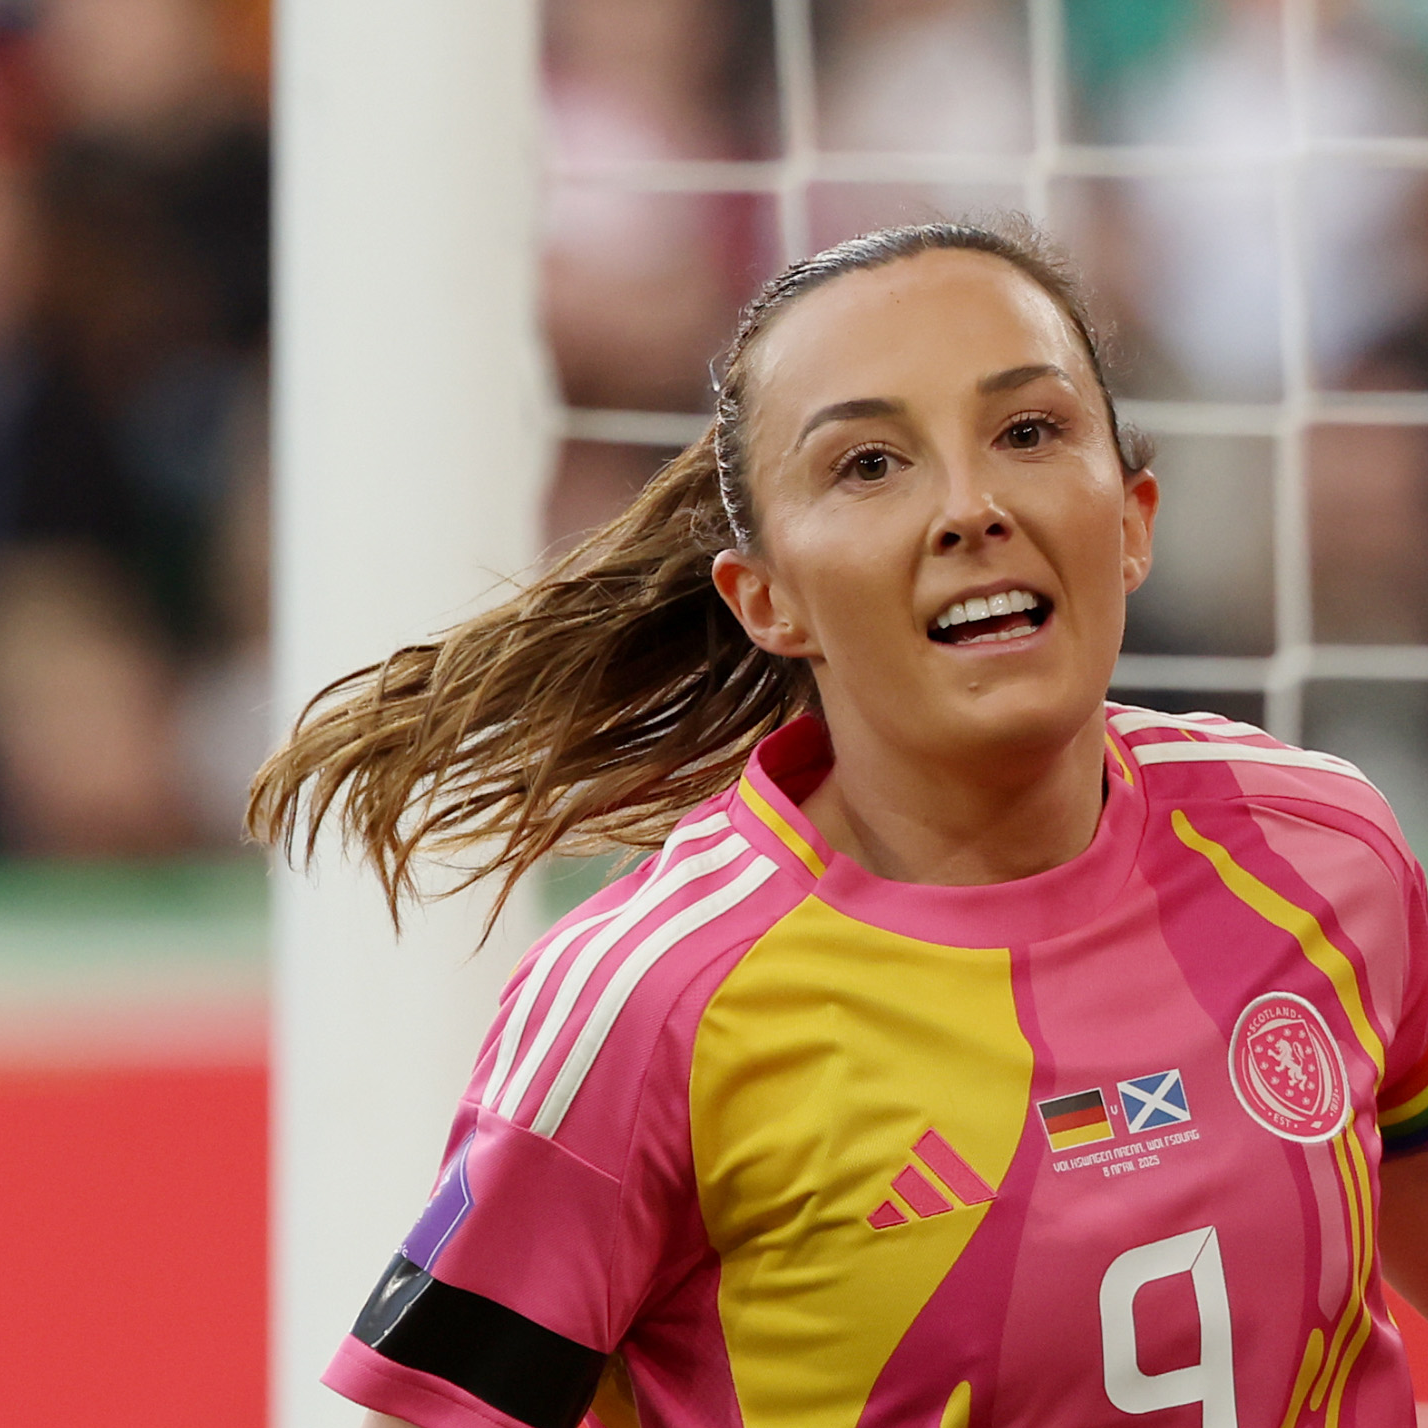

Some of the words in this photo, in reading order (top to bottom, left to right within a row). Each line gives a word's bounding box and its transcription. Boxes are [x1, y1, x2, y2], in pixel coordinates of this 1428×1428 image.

[1248, 1006, 1297, 1033] SCOTLAND
[1273, 1113, 1292, 1128] EST
[1110, 1161, 1135, 1175] APRIL
[1138, 1154, 1161, 1169] 2025
